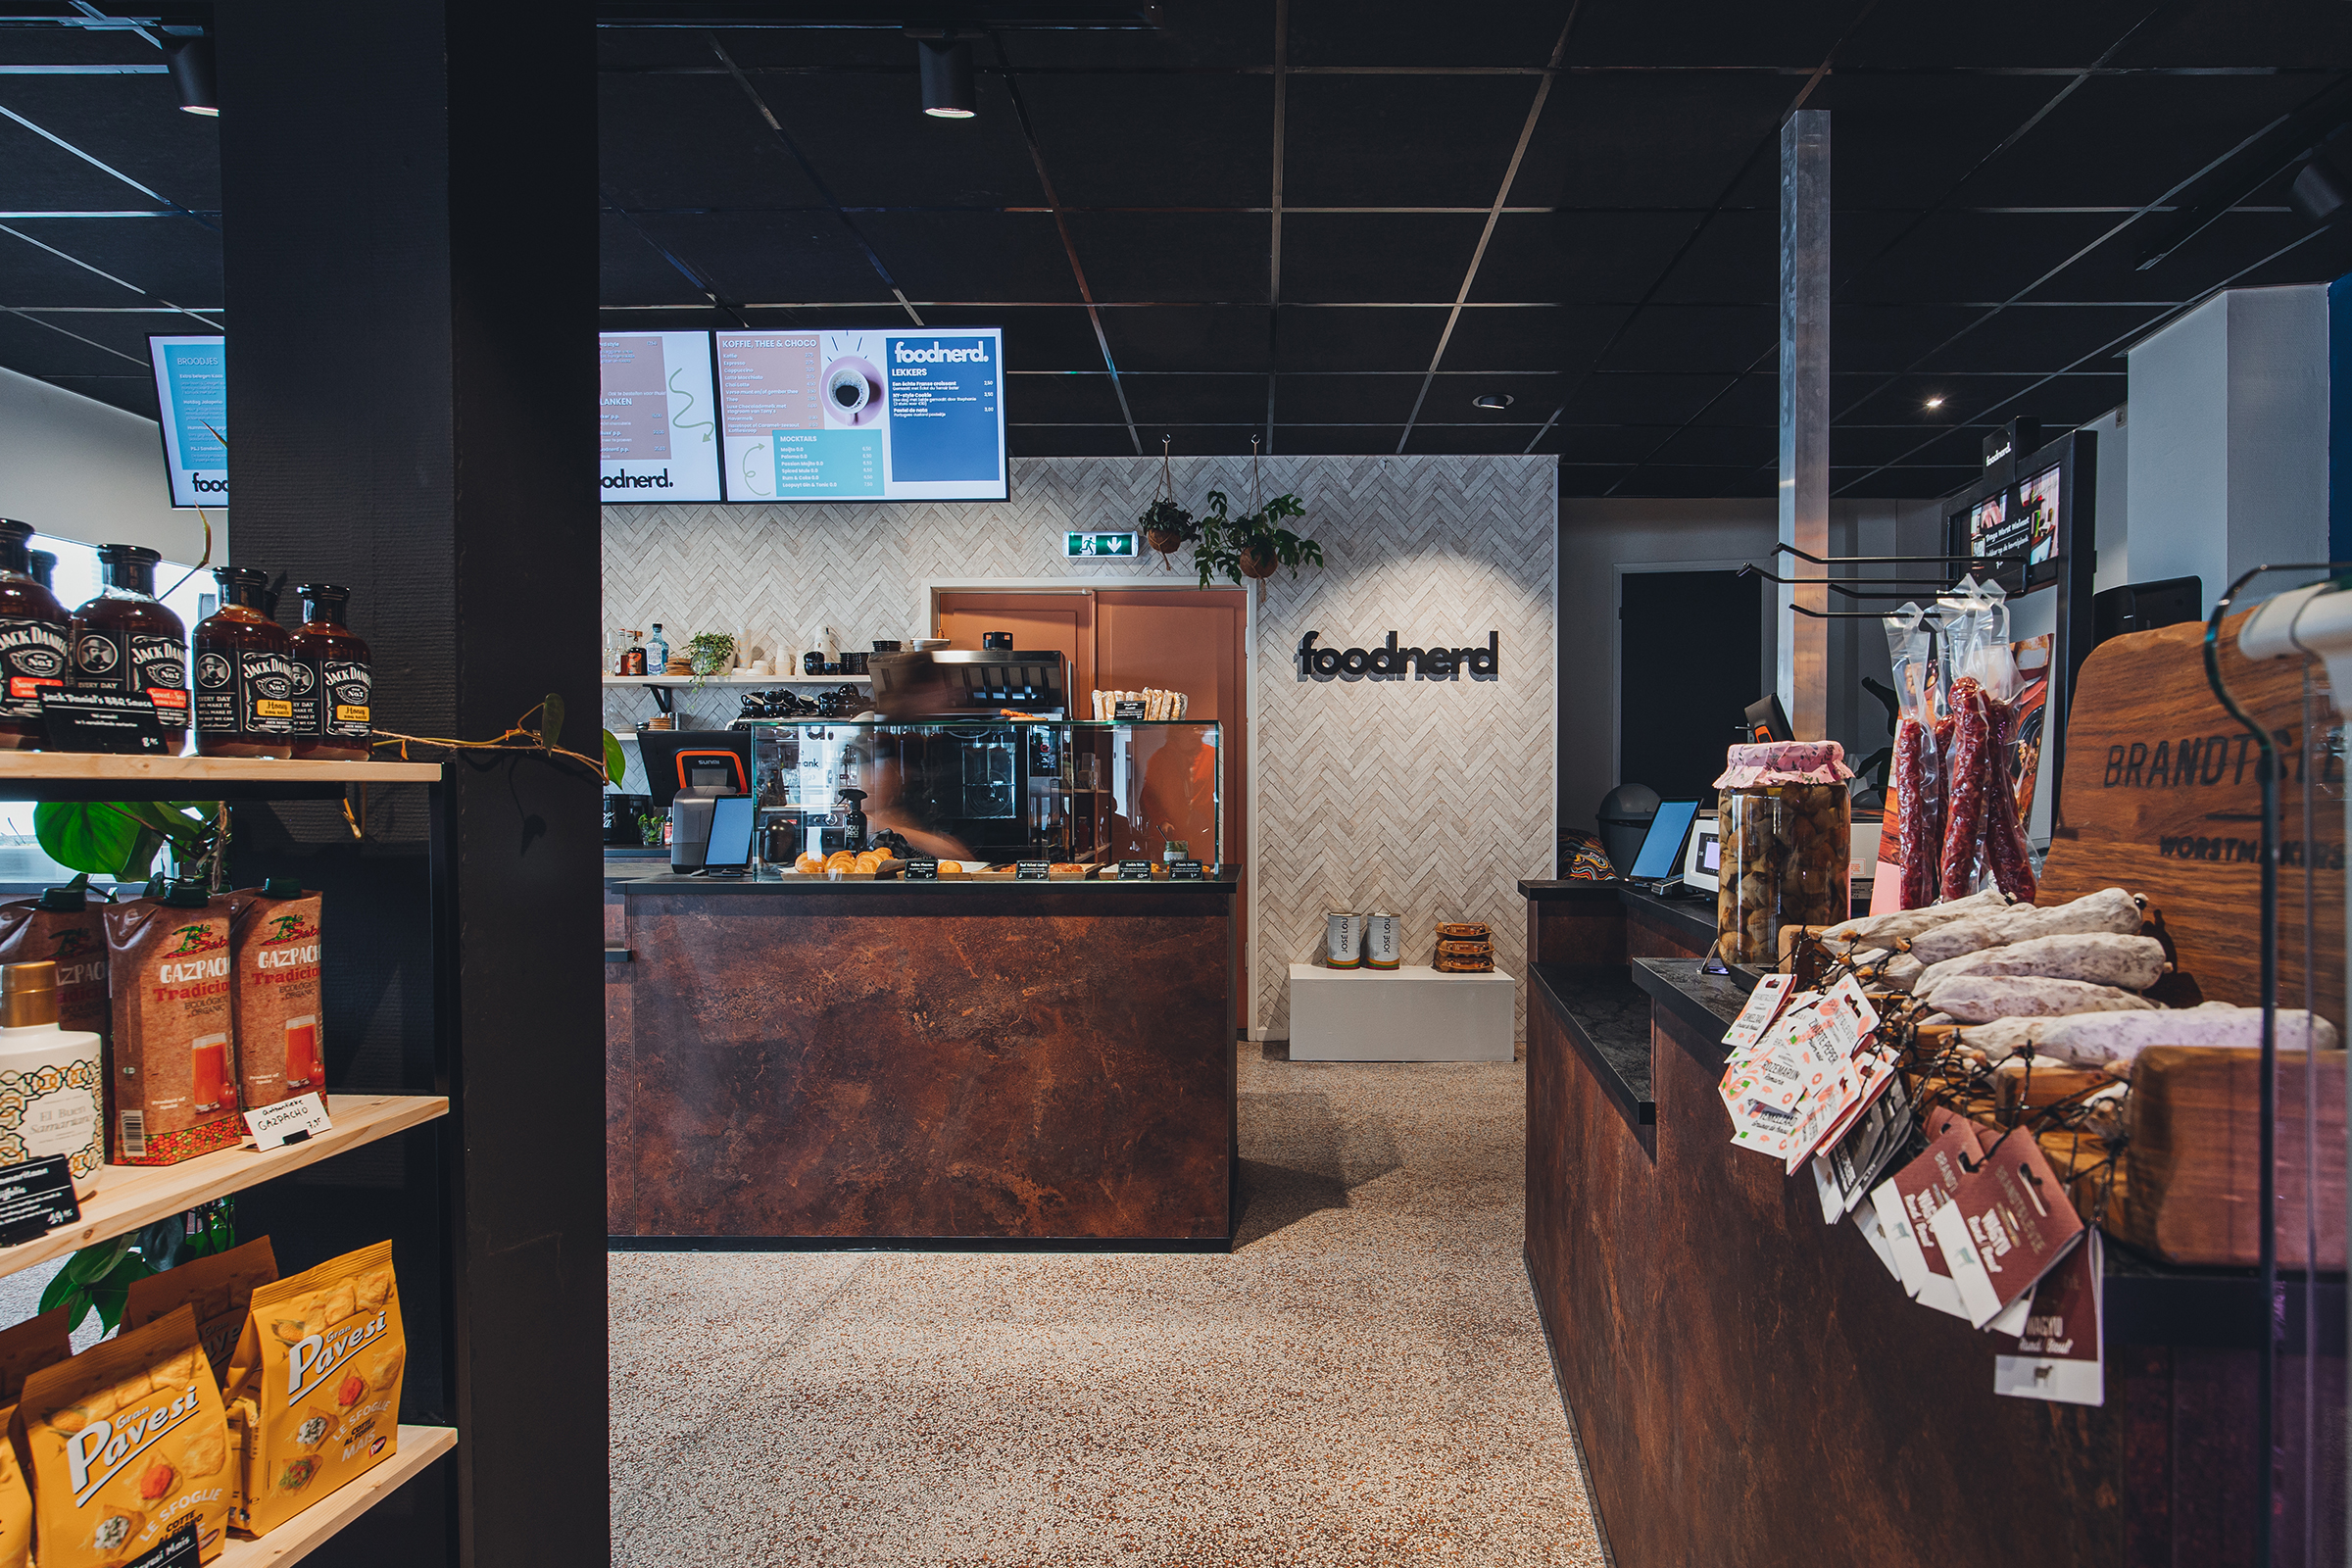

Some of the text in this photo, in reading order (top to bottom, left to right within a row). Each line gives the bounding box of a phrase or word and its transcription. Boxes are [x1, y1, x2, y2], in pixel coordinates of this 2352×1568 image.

[722, 340, 817, 349] KOFFIE, THEE & CHOCO
[895, 341, 989, 363] foodnerd.
[600, 468, 673, 488] odnerd.
[131, 645, 165, 664] JACK
[1298, 630, 1498, 675] foodnerd
[242, 662, 271, 679] JACK
[323, 669, 351, 686] JACK
[258, 944, 321, 969] GAZPACH
[160, 956, 230, 984] GAZPACH
[153, 981, 230, 1002] Tradicio
[1823, 1041, 1838, 1065] PEPER
[28, 1113, 93, 1135] Samaritano
[40, 1105, 86, 1122] El Buen
[326, 1325, 352, 1345] Gran
[288, 1310, 387, 1396] Pavesi
[116, 1406, 150, 1430] Gran
[332, 1400, 391, 1442] LE SFOGLIE
[351, 1417, 372, 1436] COTTE
[66, 1386, 200, 1495] Pavesi
[342, 1429, 376, 1462] MAIS
[344, 1436, 354, 1446] AL
[139, 1488, 223, 1542] LE SFOGLIE
[166, 1510, 195, 1533] COTTE
[165, 1536, 191, 1556] Mais
